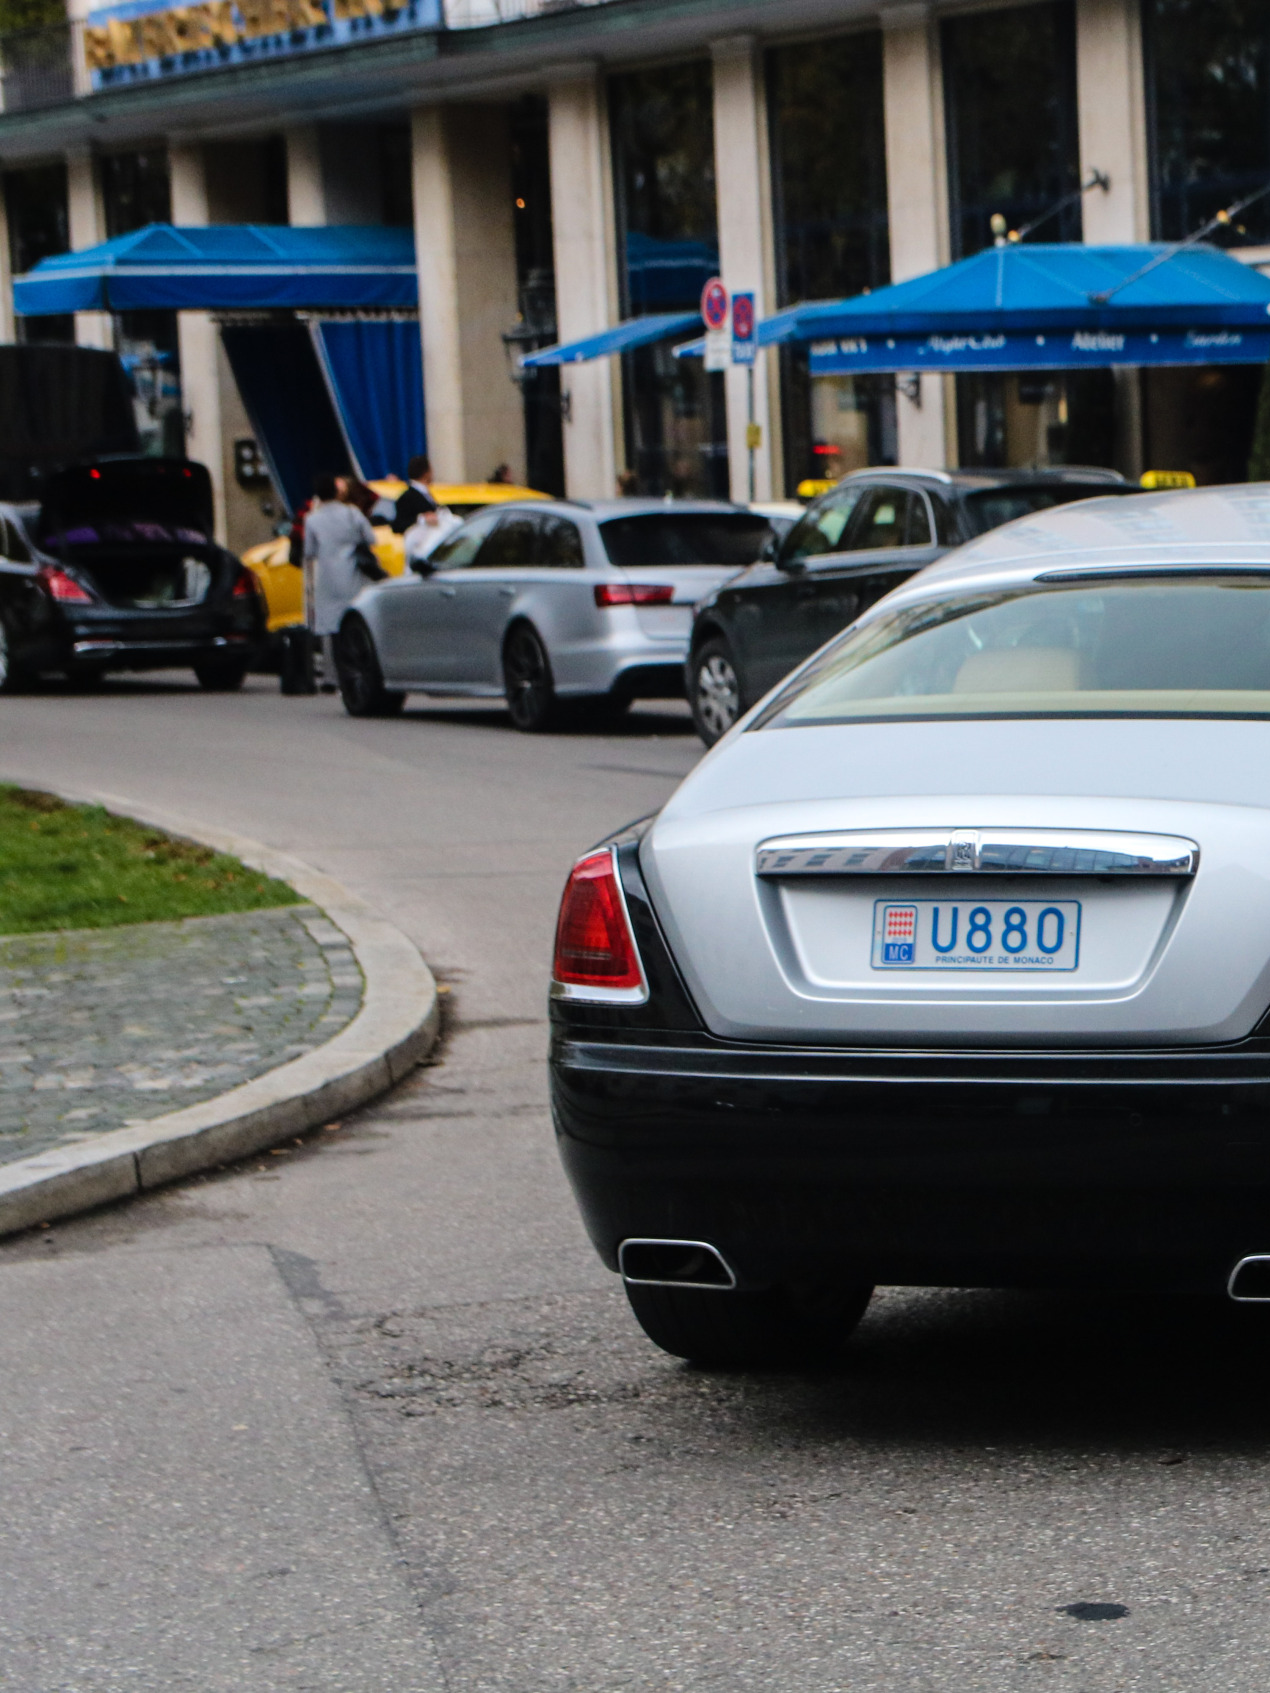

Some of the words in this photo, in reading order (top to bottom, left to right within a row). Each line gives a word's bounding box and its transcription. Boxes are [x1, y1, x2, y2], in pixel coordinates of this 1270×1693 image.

[932, 906, 1065, 954] U880
[889, 944, 909, 961] MC
[935, 955, 994, 965] PRINCIPAUTE
[997, 955, 1010, 965] DE
[1013, 956, 1054, 966] MONACO
